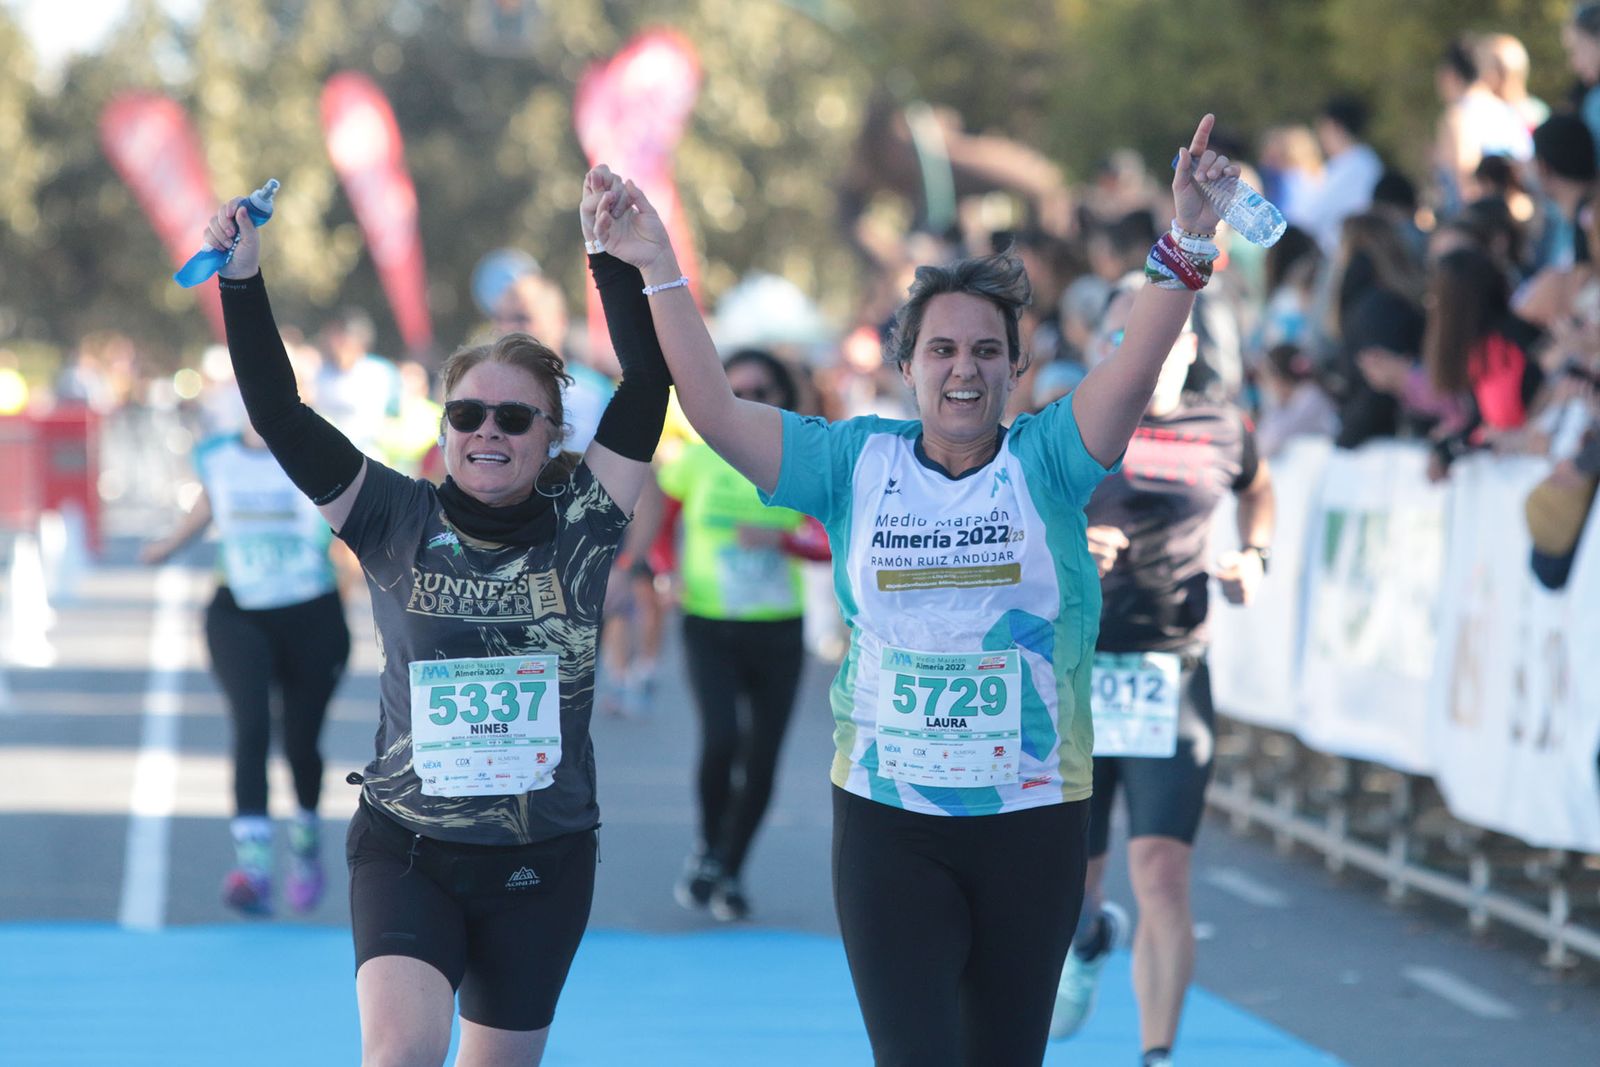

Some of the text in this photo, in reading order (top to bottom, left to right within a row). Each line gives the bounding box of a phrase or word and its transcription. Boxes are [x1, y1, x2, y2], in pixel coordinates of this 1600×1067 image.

[1180, 261, 1193, 277] Day
[875, 513, 927, 527] Medio
[871, 530, 951, 549] Almería
[871, 550, 1014, 568] RAMÓN RUIZ ANDÚJAR
[536, 572, 558, 610] TEAM
[407, 589, 532, 615] FOREVER
[486, 668, 505, 676] 2022
[892, 673, 1008, 718] 5729
[1092, 674, 1165, 703] 012
[428, 681, 547, 726] 5337
[470, 723, 508, 734] NINES
[926, 717, 968, 728] LAURA
